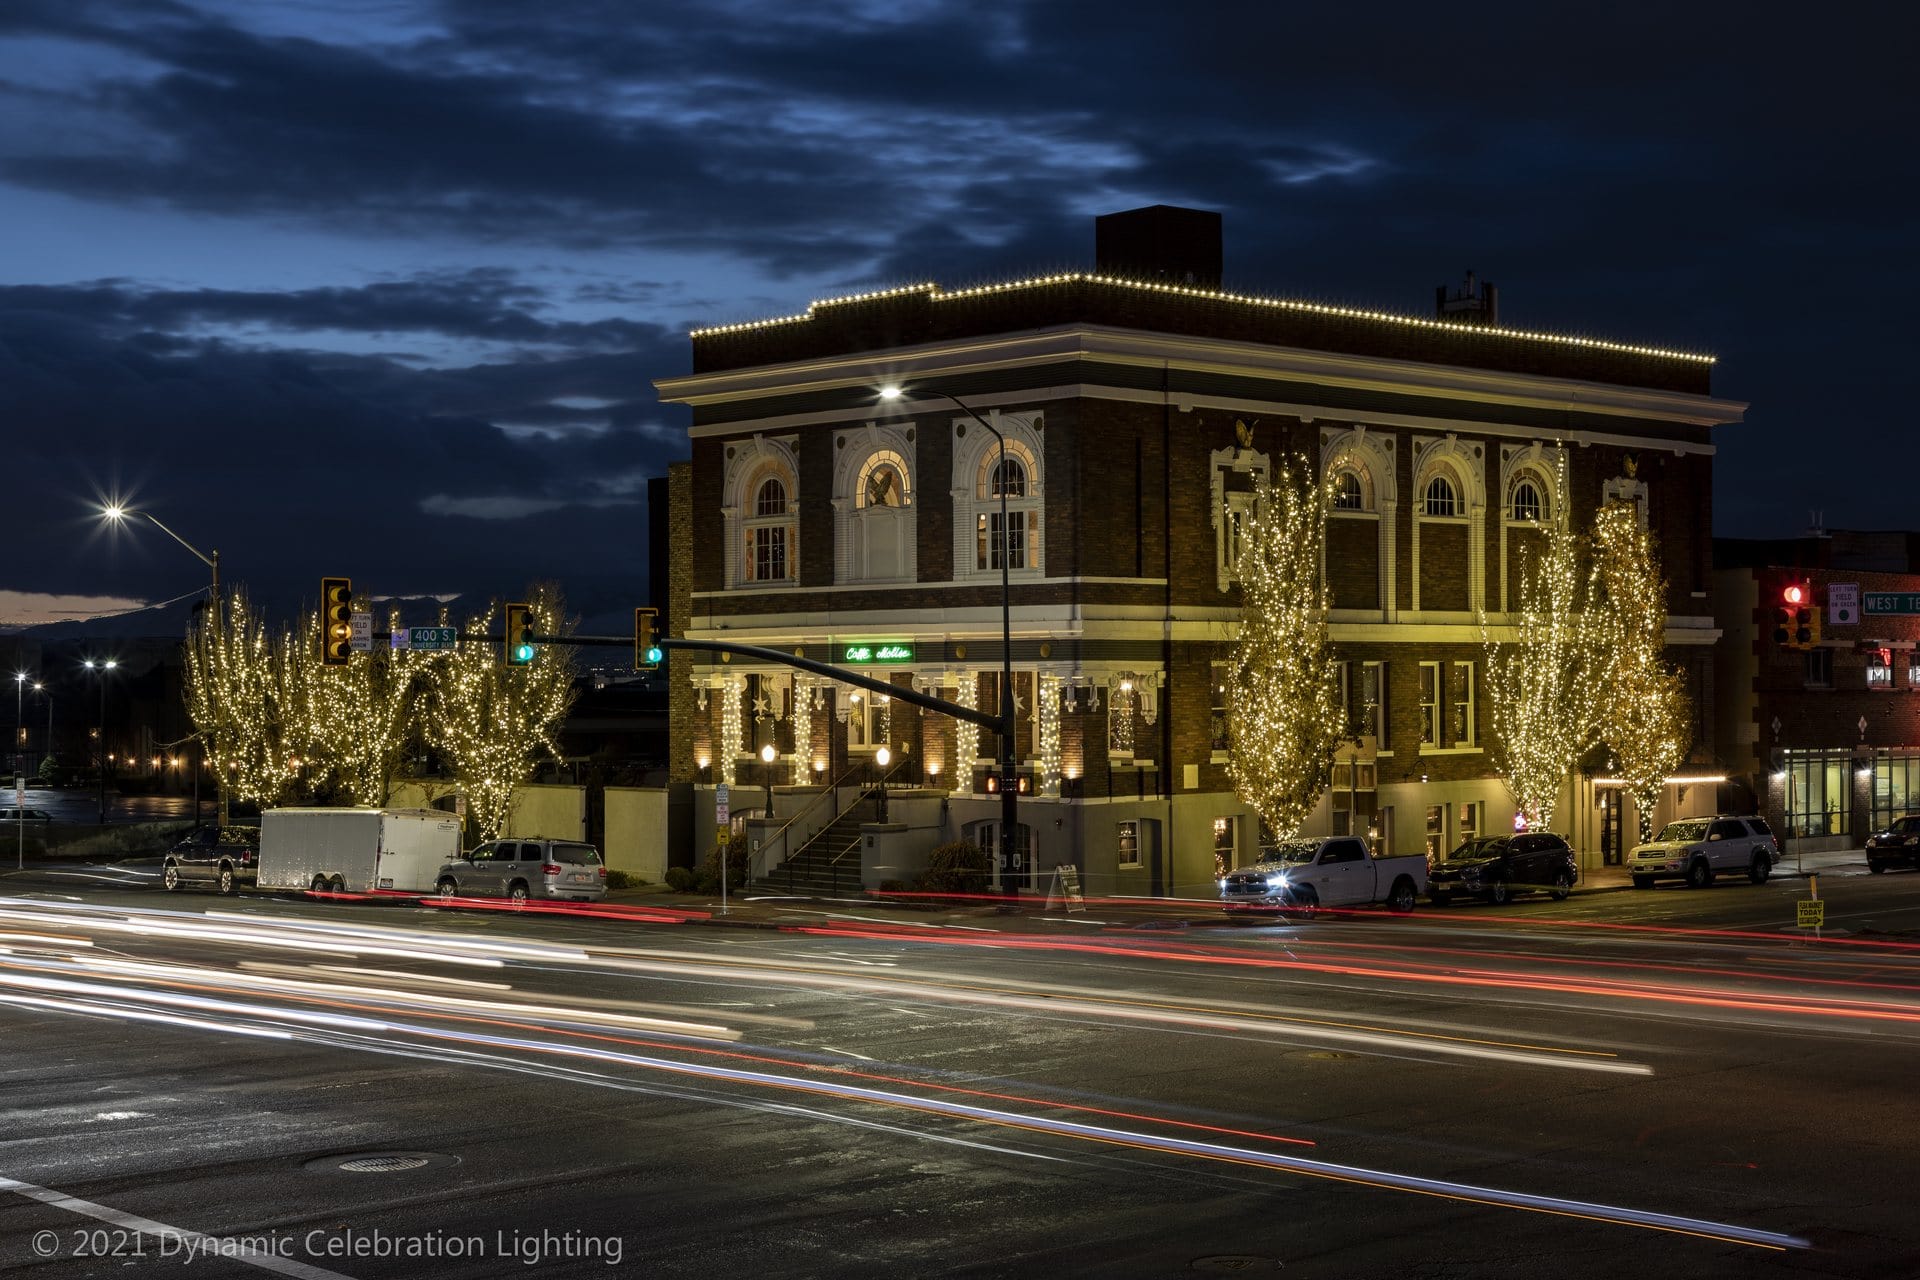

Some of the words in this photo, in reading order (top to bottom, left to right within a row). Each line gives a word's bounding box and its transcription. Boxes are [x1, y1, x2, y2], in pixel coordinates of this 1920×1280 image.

[1867, 597, 1899, 610] WEST
[415, 630, 437, 641] 400
[442, 630, 452, 641] S.
